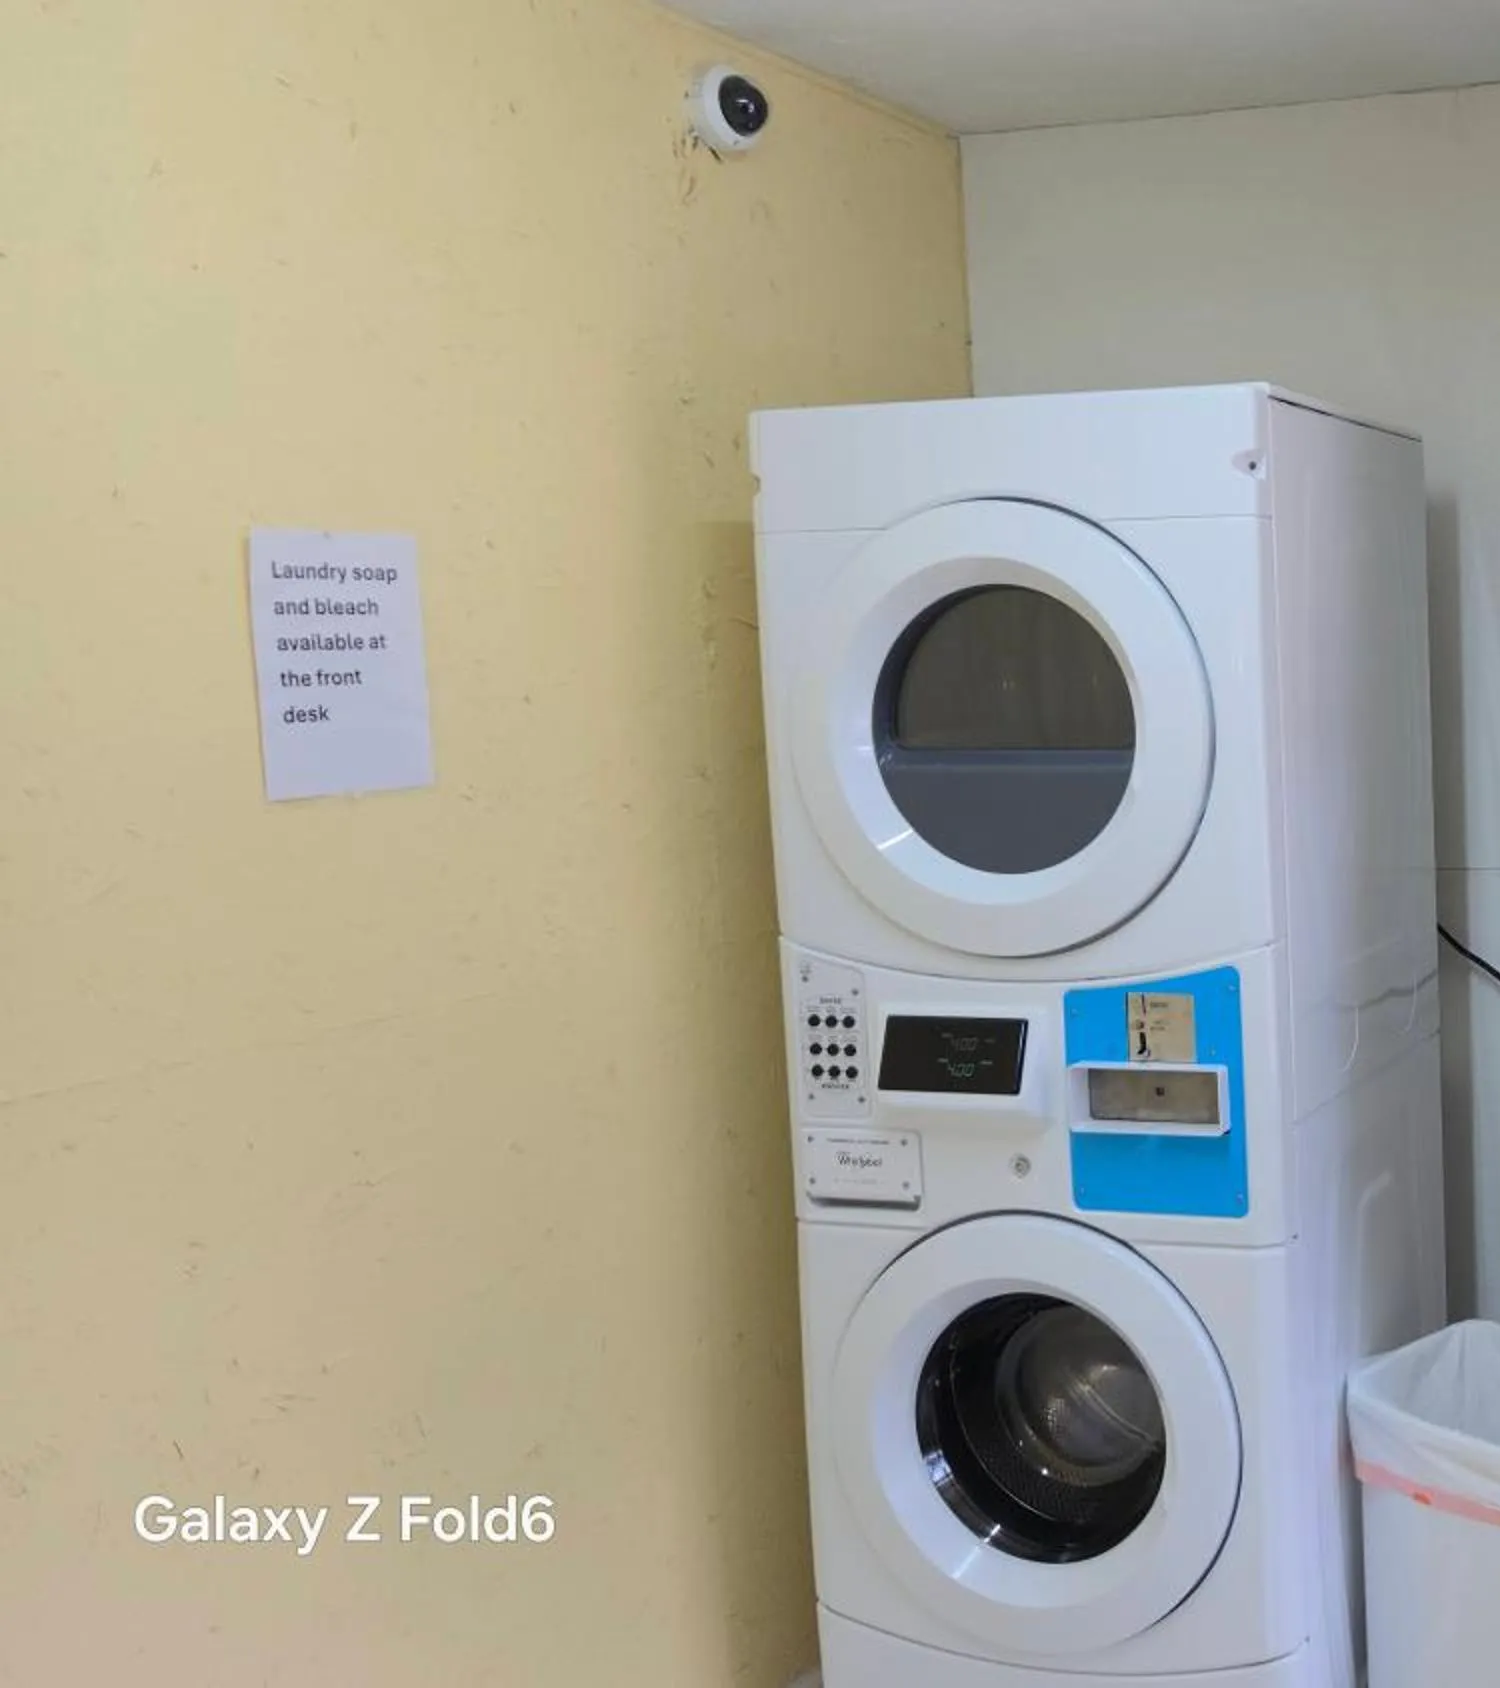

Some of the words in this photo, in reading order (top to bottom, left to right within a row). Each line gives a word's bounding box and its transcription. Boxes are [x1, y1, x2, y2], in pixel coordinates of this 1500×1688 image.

[271, 561, 347, 583] Laundry
[352, 567, 398, 584] soap
[273, 598, 310, 615] and
[314, 598, 380, 616] bleach
[276, 634, 365, 652] available
[368, 635, 387, 650] at
[280, 670, 312, 687] the
[316, 669, 363, 686] front
[283, 705, 331, 724] desk
